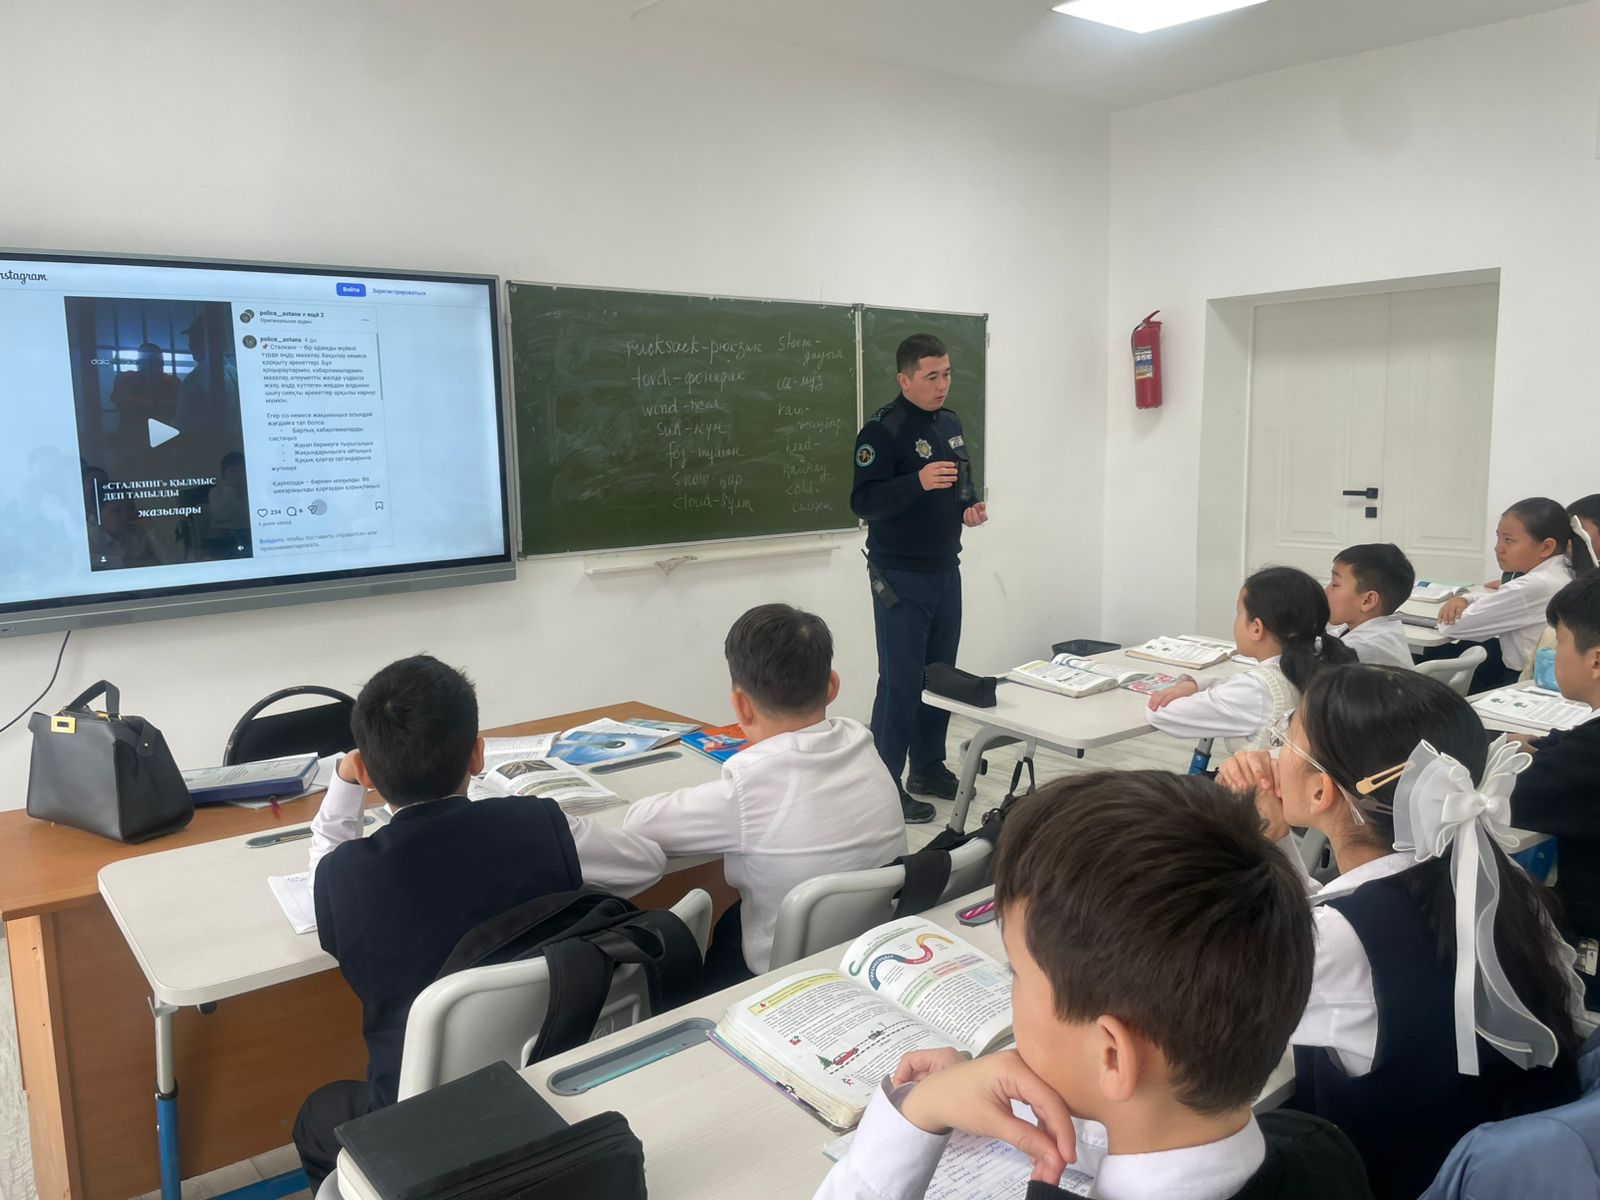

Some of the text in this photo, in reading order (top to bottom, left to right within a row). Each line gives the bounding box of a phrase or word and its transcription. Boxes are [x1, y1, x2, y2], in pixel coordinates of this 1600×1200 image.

[342, 285, 361, 294] Войти
[371, 287, 427, 296] Зарегистрироваться
[102, 476, 217, 491] «СТАЛКИНГ» ҚЫЛМЫС
[103, 489, 180, 501] ДЕП ТАНЫЛДЫ
[137, 505, 202, 518] жазылары
